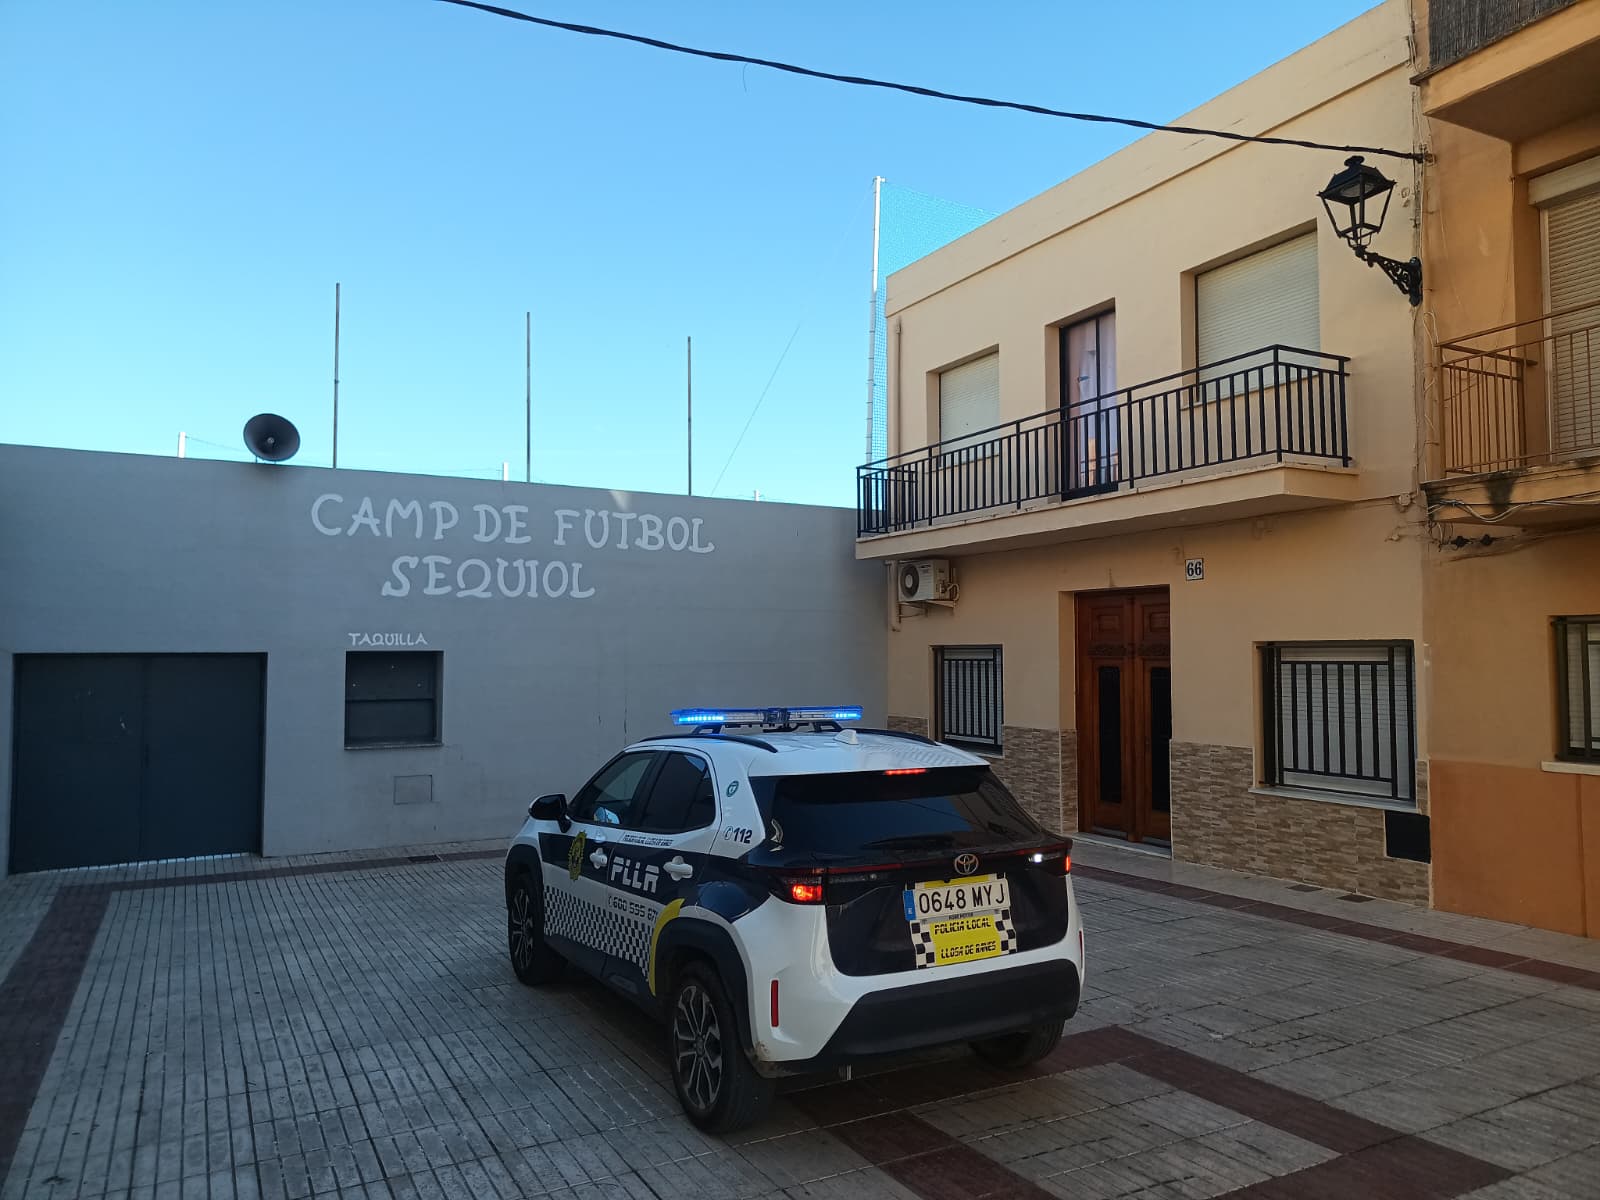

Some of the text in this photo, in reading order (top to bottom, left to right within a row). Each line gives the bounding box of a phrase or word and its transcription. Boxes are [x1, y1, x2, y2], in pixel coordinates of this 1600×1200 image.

[310, 493, 716, 554] CAMP DE FUTBOL
[381, 555, 596, 599] SEQUIOL
[1187, 561, 1202, 577] 66
[348, 632, 428, 647] TAQUILLA
[733, 827, 753, 844] 112
[918, 883, 1005, 914] 0648 MYJ
[934, 917, 992, 935] POLICIA LOCAL
[940, 946, 963, 959] LLOSA
[965, 943, 974, 955] DE
